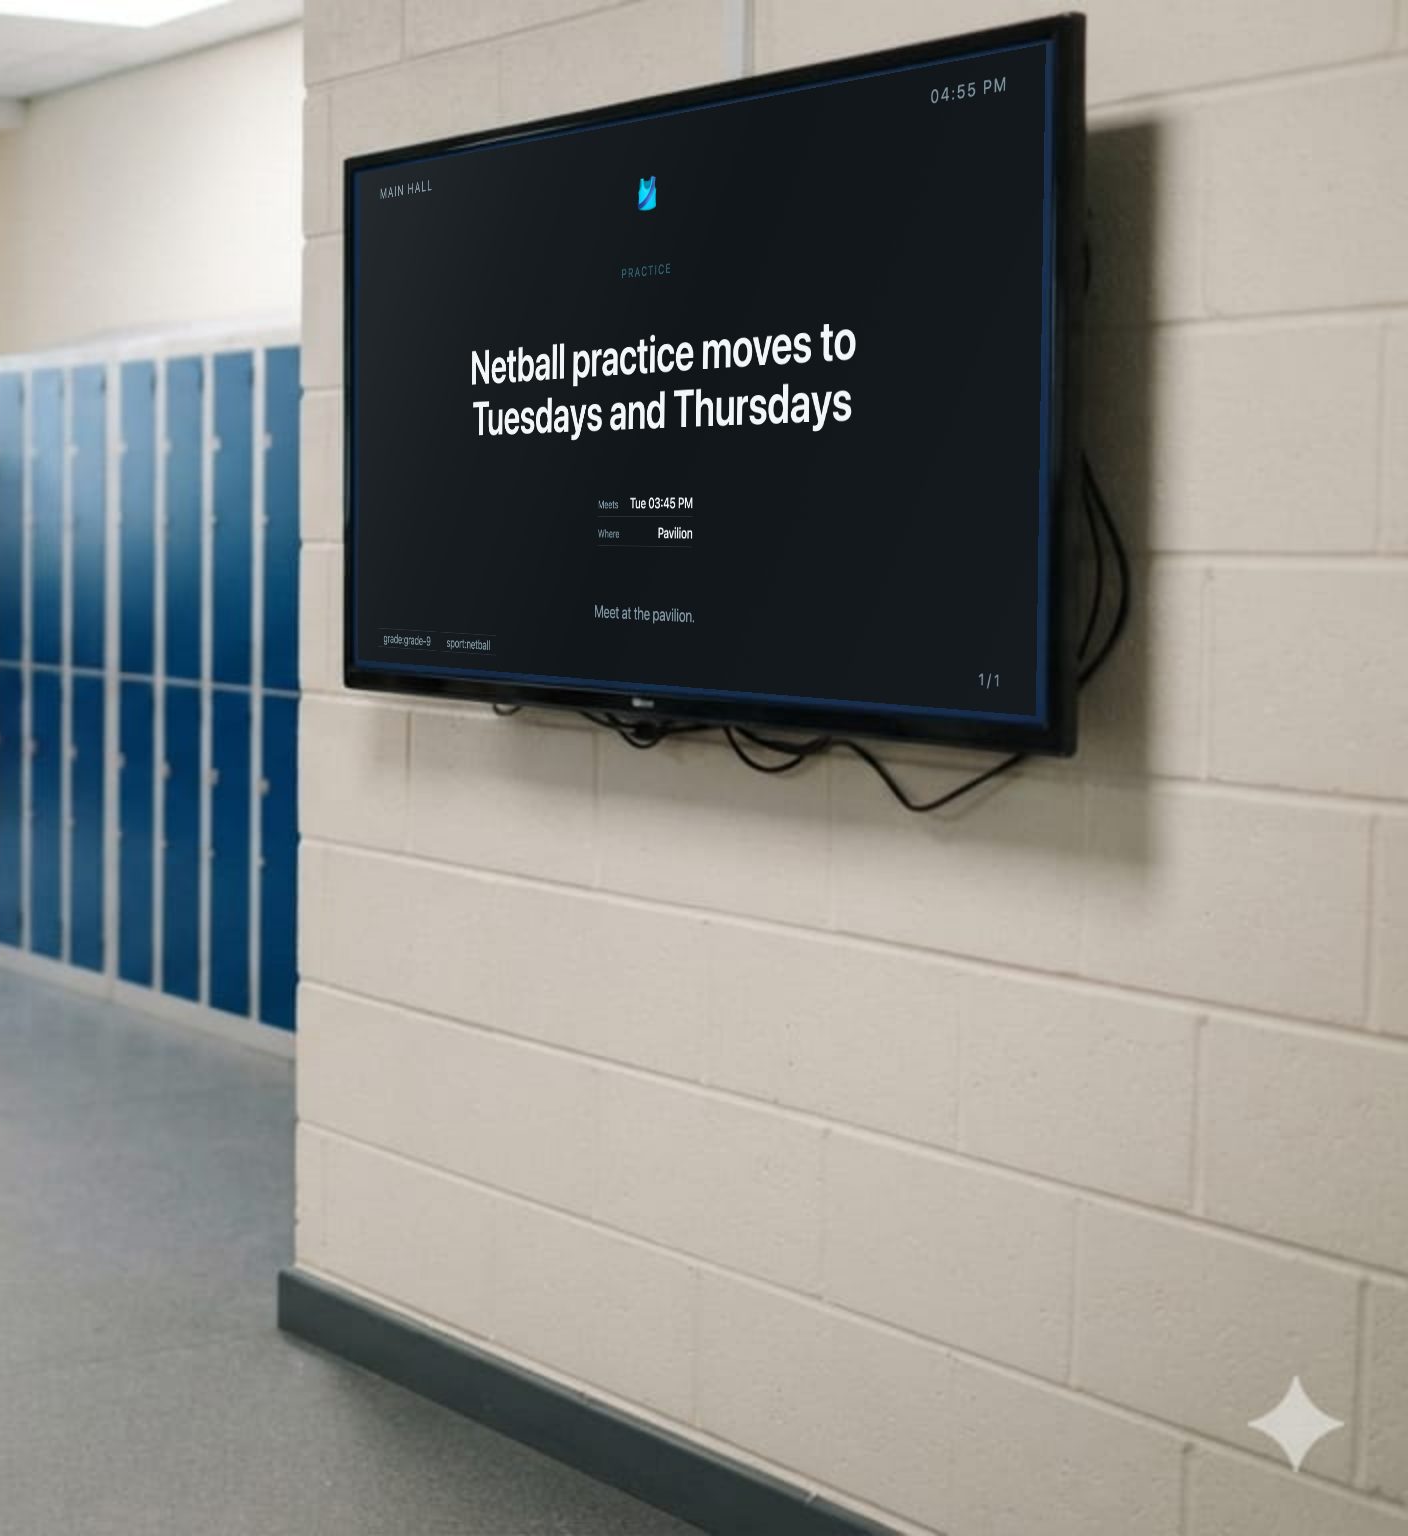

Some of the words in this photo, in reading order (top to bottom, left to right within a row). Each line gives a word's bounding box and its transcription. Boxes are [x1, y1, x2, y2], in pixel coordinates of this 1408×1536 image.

[930, 81, 976, 104] 04:55
[983, 76, 1007, 95] PM
[379, 184, 404, 199] MAIN
[407, 179, 433, 194] HALL
[621, 263, 671, 280] PRACTICE
[471, 343, 565, 386] Netball
[572, 334, 694, 387] practice
[701, 331, 812, 370] moves
[820, 323, 857, 362] to
[472, 397, 603, 441] Tuesdays
[609, 391, 666, 431] and
[673, 383, 853, 432] Thursdays
[597, 499, 619, 510] Meets
[629, 496, 647, 510] Tue
[648, 496, 676, 510] 03:45
[677, 496, 694, 510] PM
[597, 528, 620, 539] Where
[657, 526, 693, 540] Pavilion
[594, 604, 620, 620] Meet
[621, 607, 632, 620] at
[633, 606, 651, 621] the
[652, 608, 695, 624] pavilion.
[446, 638, 491, 651] sport:netball
[978, 672, 1000, 689] 1/1
